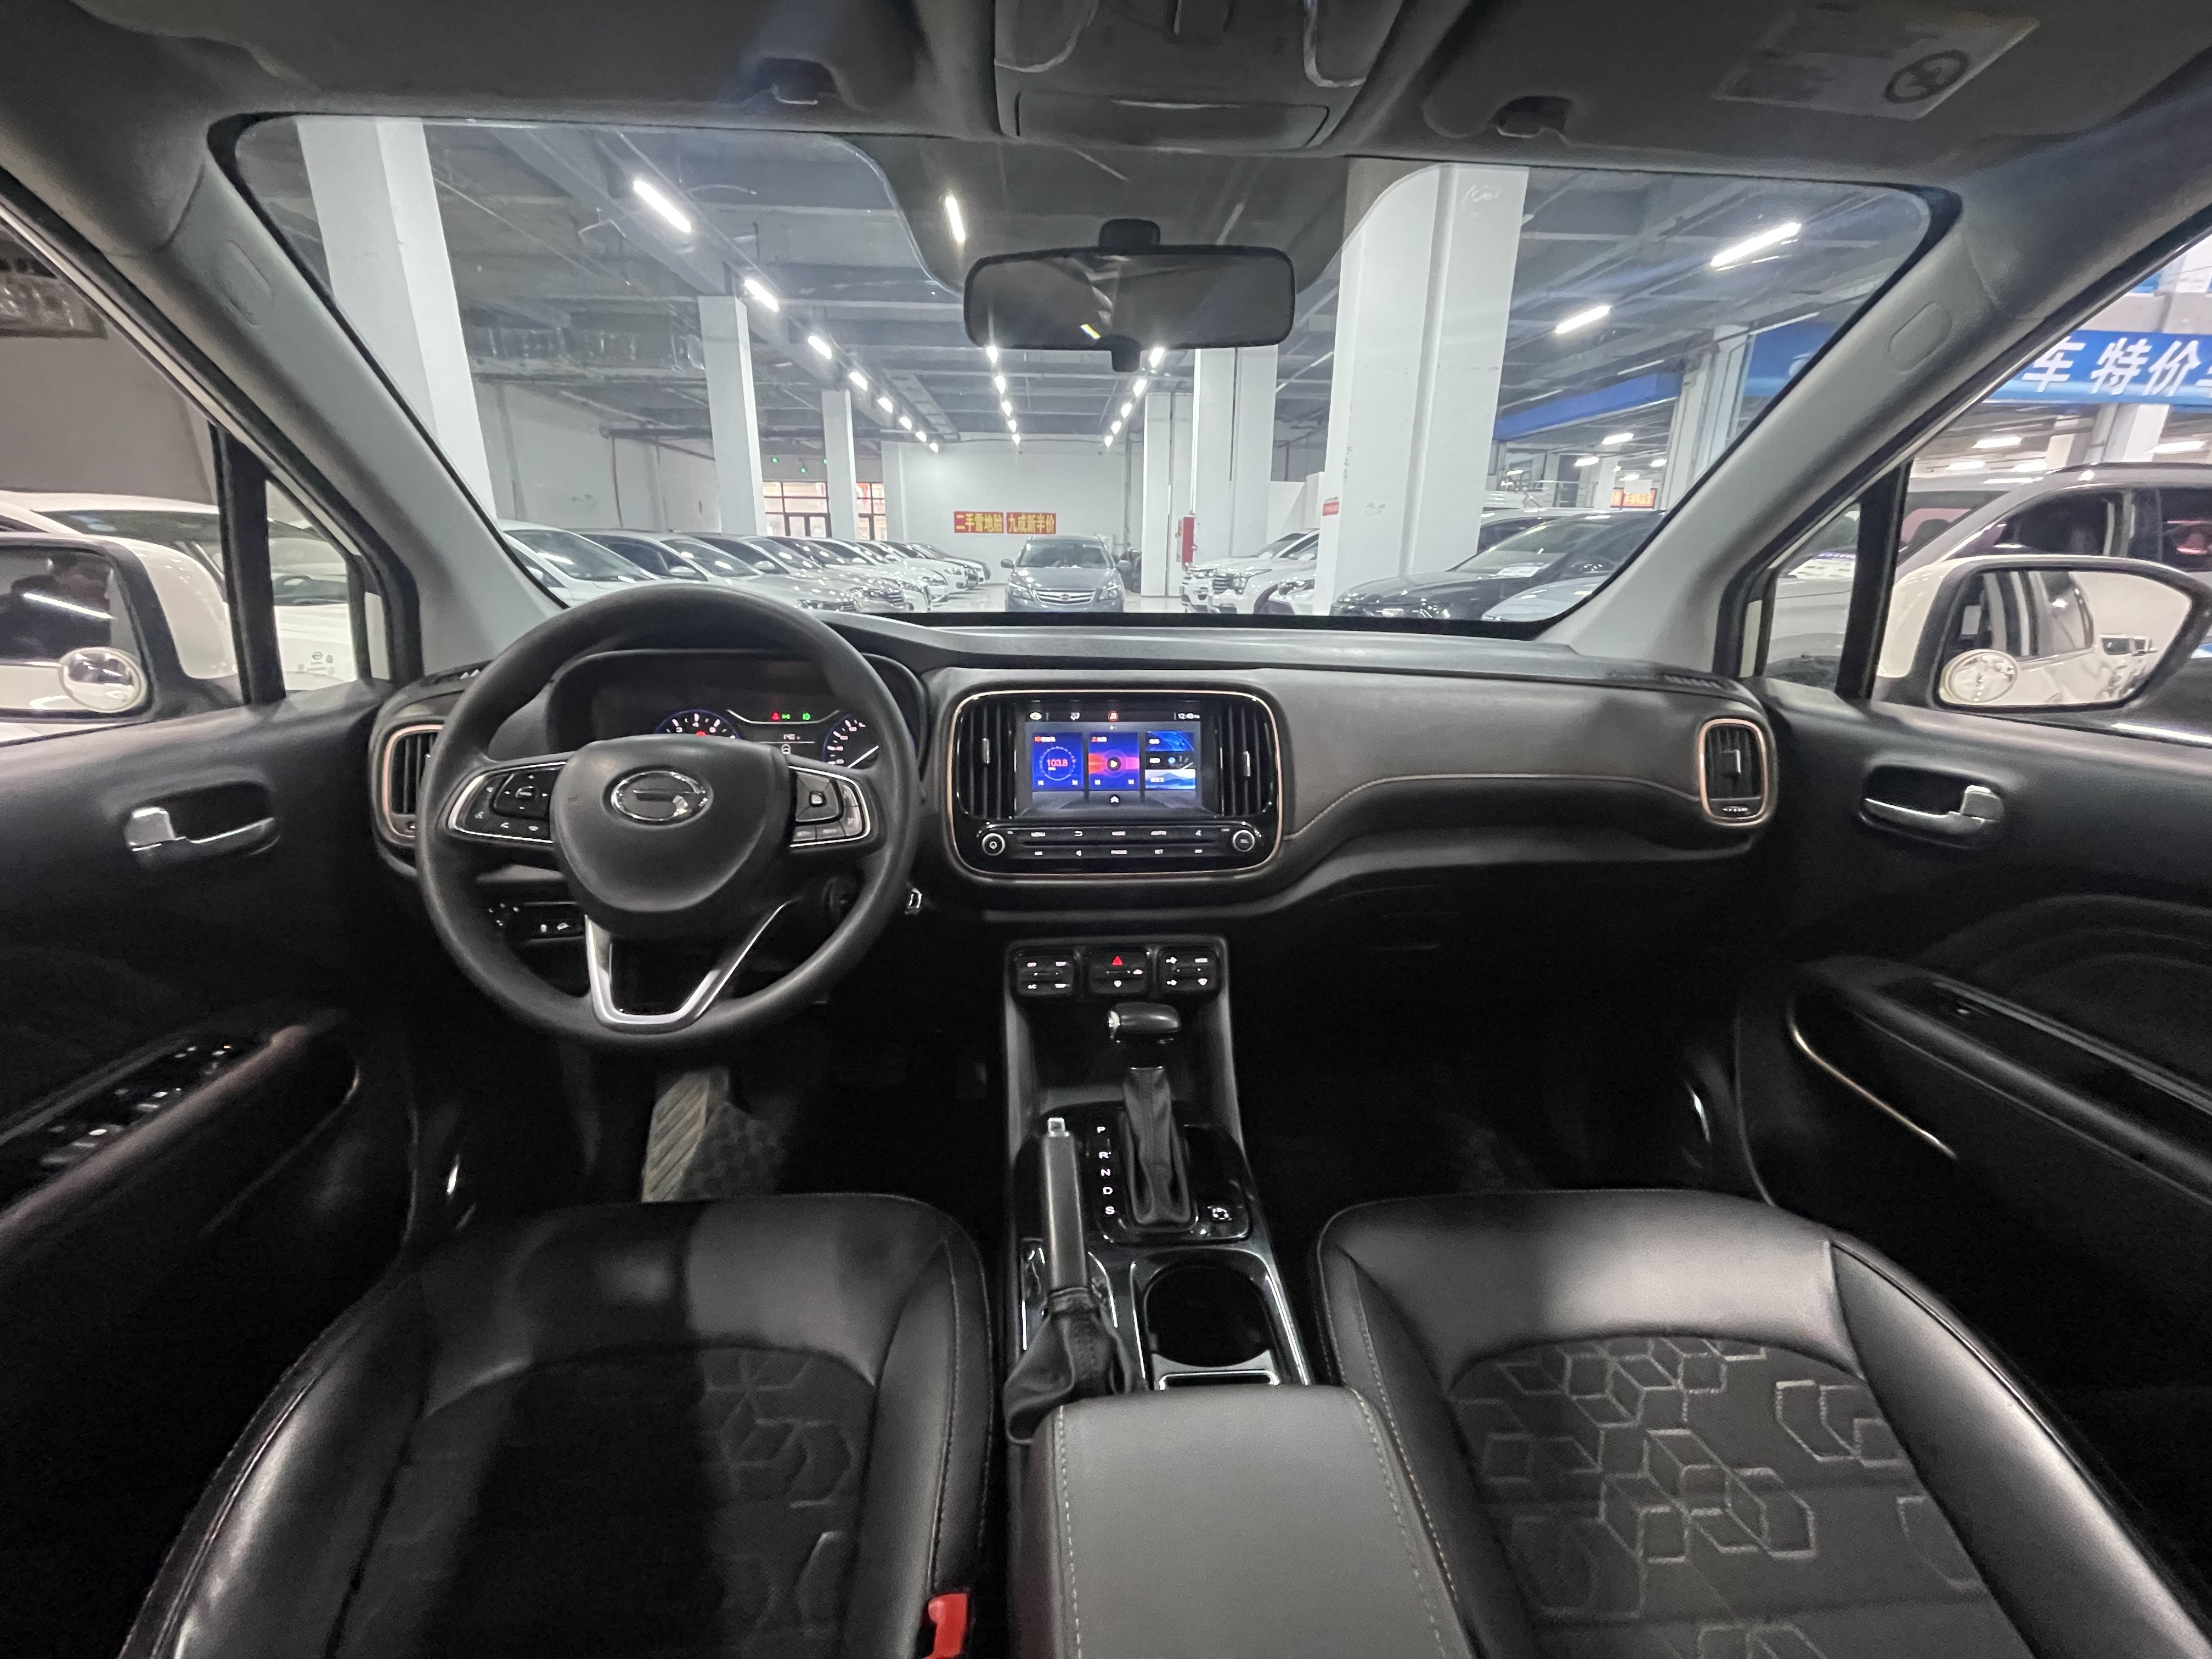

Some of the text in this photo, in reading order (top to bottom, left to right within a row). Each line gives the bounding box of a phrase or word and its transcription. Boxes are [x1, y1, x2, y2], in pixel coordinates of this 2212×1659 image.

[2091, 337, 2212, 398] 特价
[1008, 514, 1055, 534] 九成新半价
[1098, 1151, 1109, 1159] R
[1103, 1187, 1113, 1195] D
[1105, 1206, 1115, 1215] S
